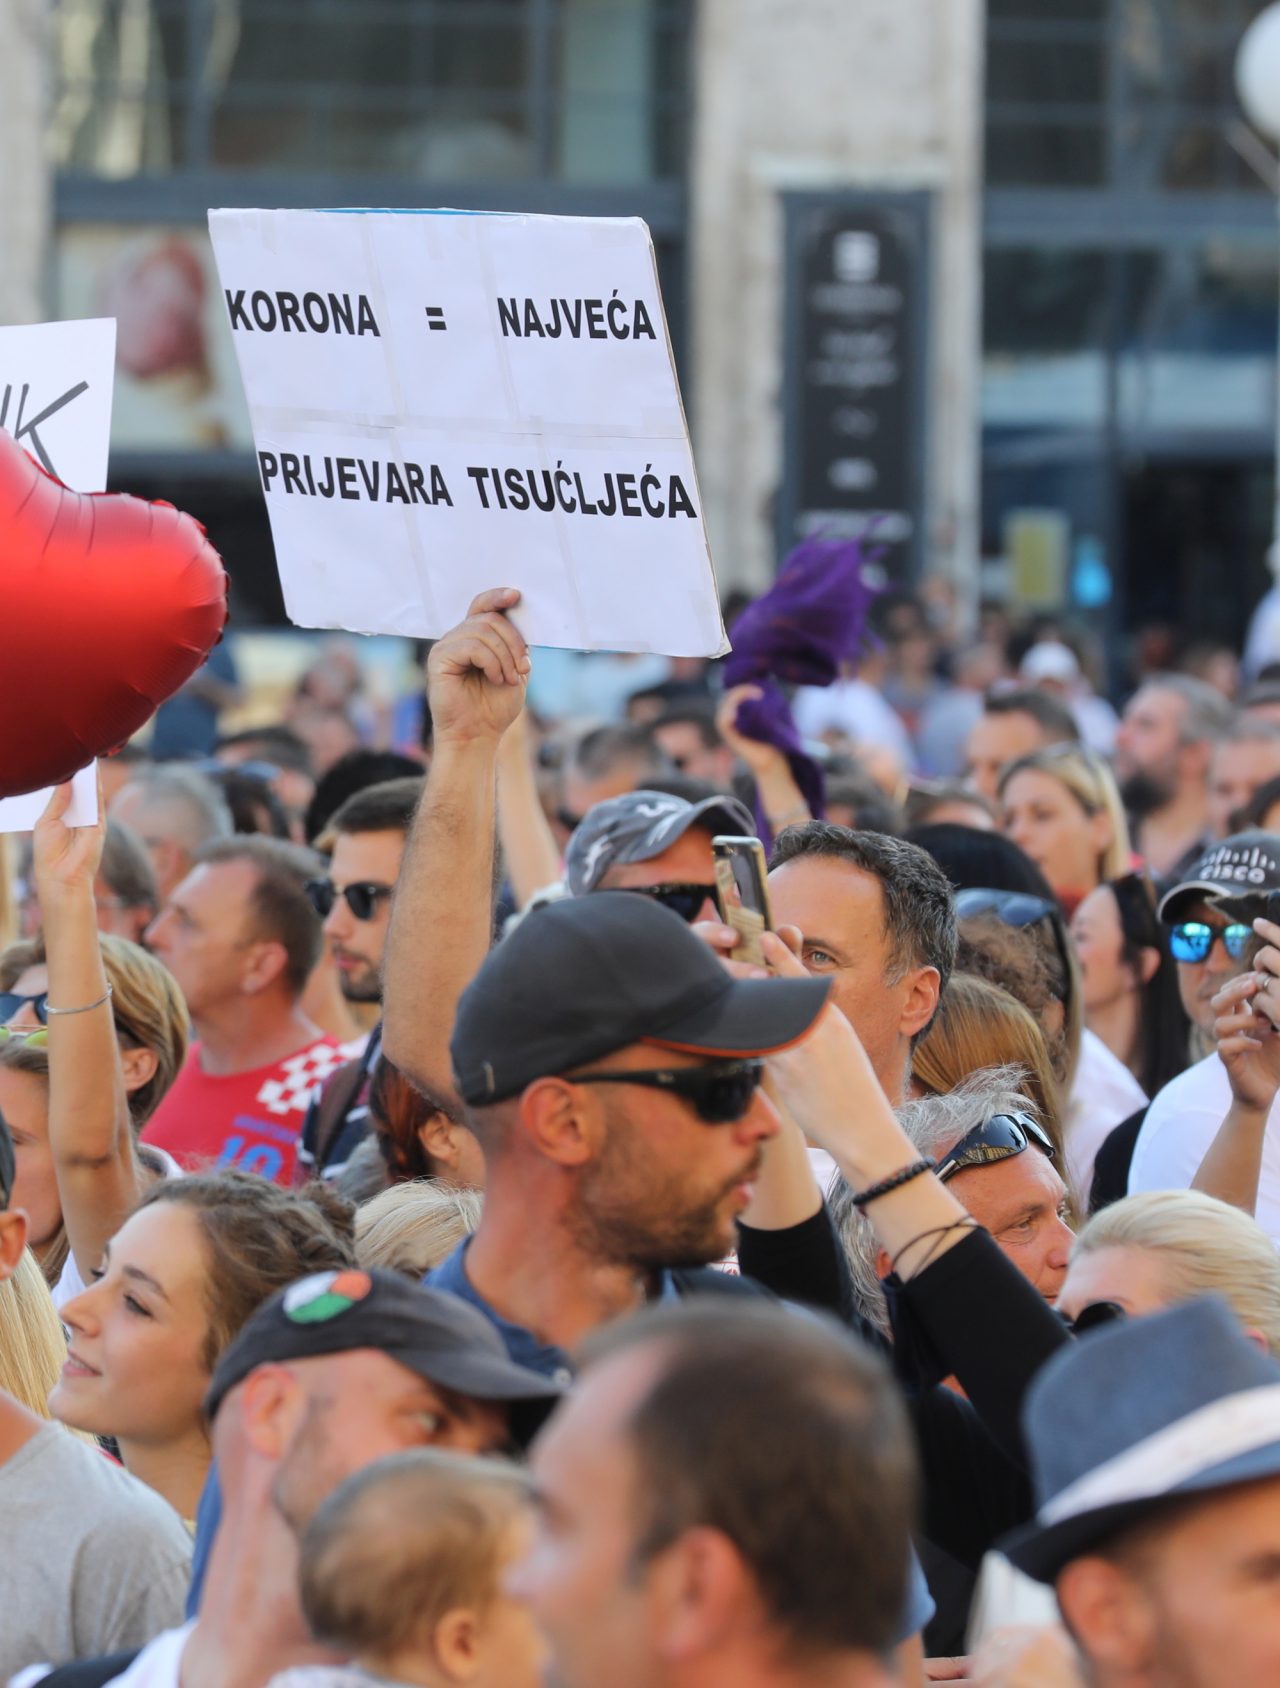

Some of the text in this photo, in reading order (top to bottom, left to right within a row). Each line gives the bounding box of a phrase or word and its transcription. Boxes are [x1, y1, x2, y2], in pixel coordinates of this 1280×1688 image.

[225, 289, 657, 340] KORONA = NAJVEĆA
[258, 451, 698, 519] PRIJEVARA TISUĆLJEĆA
